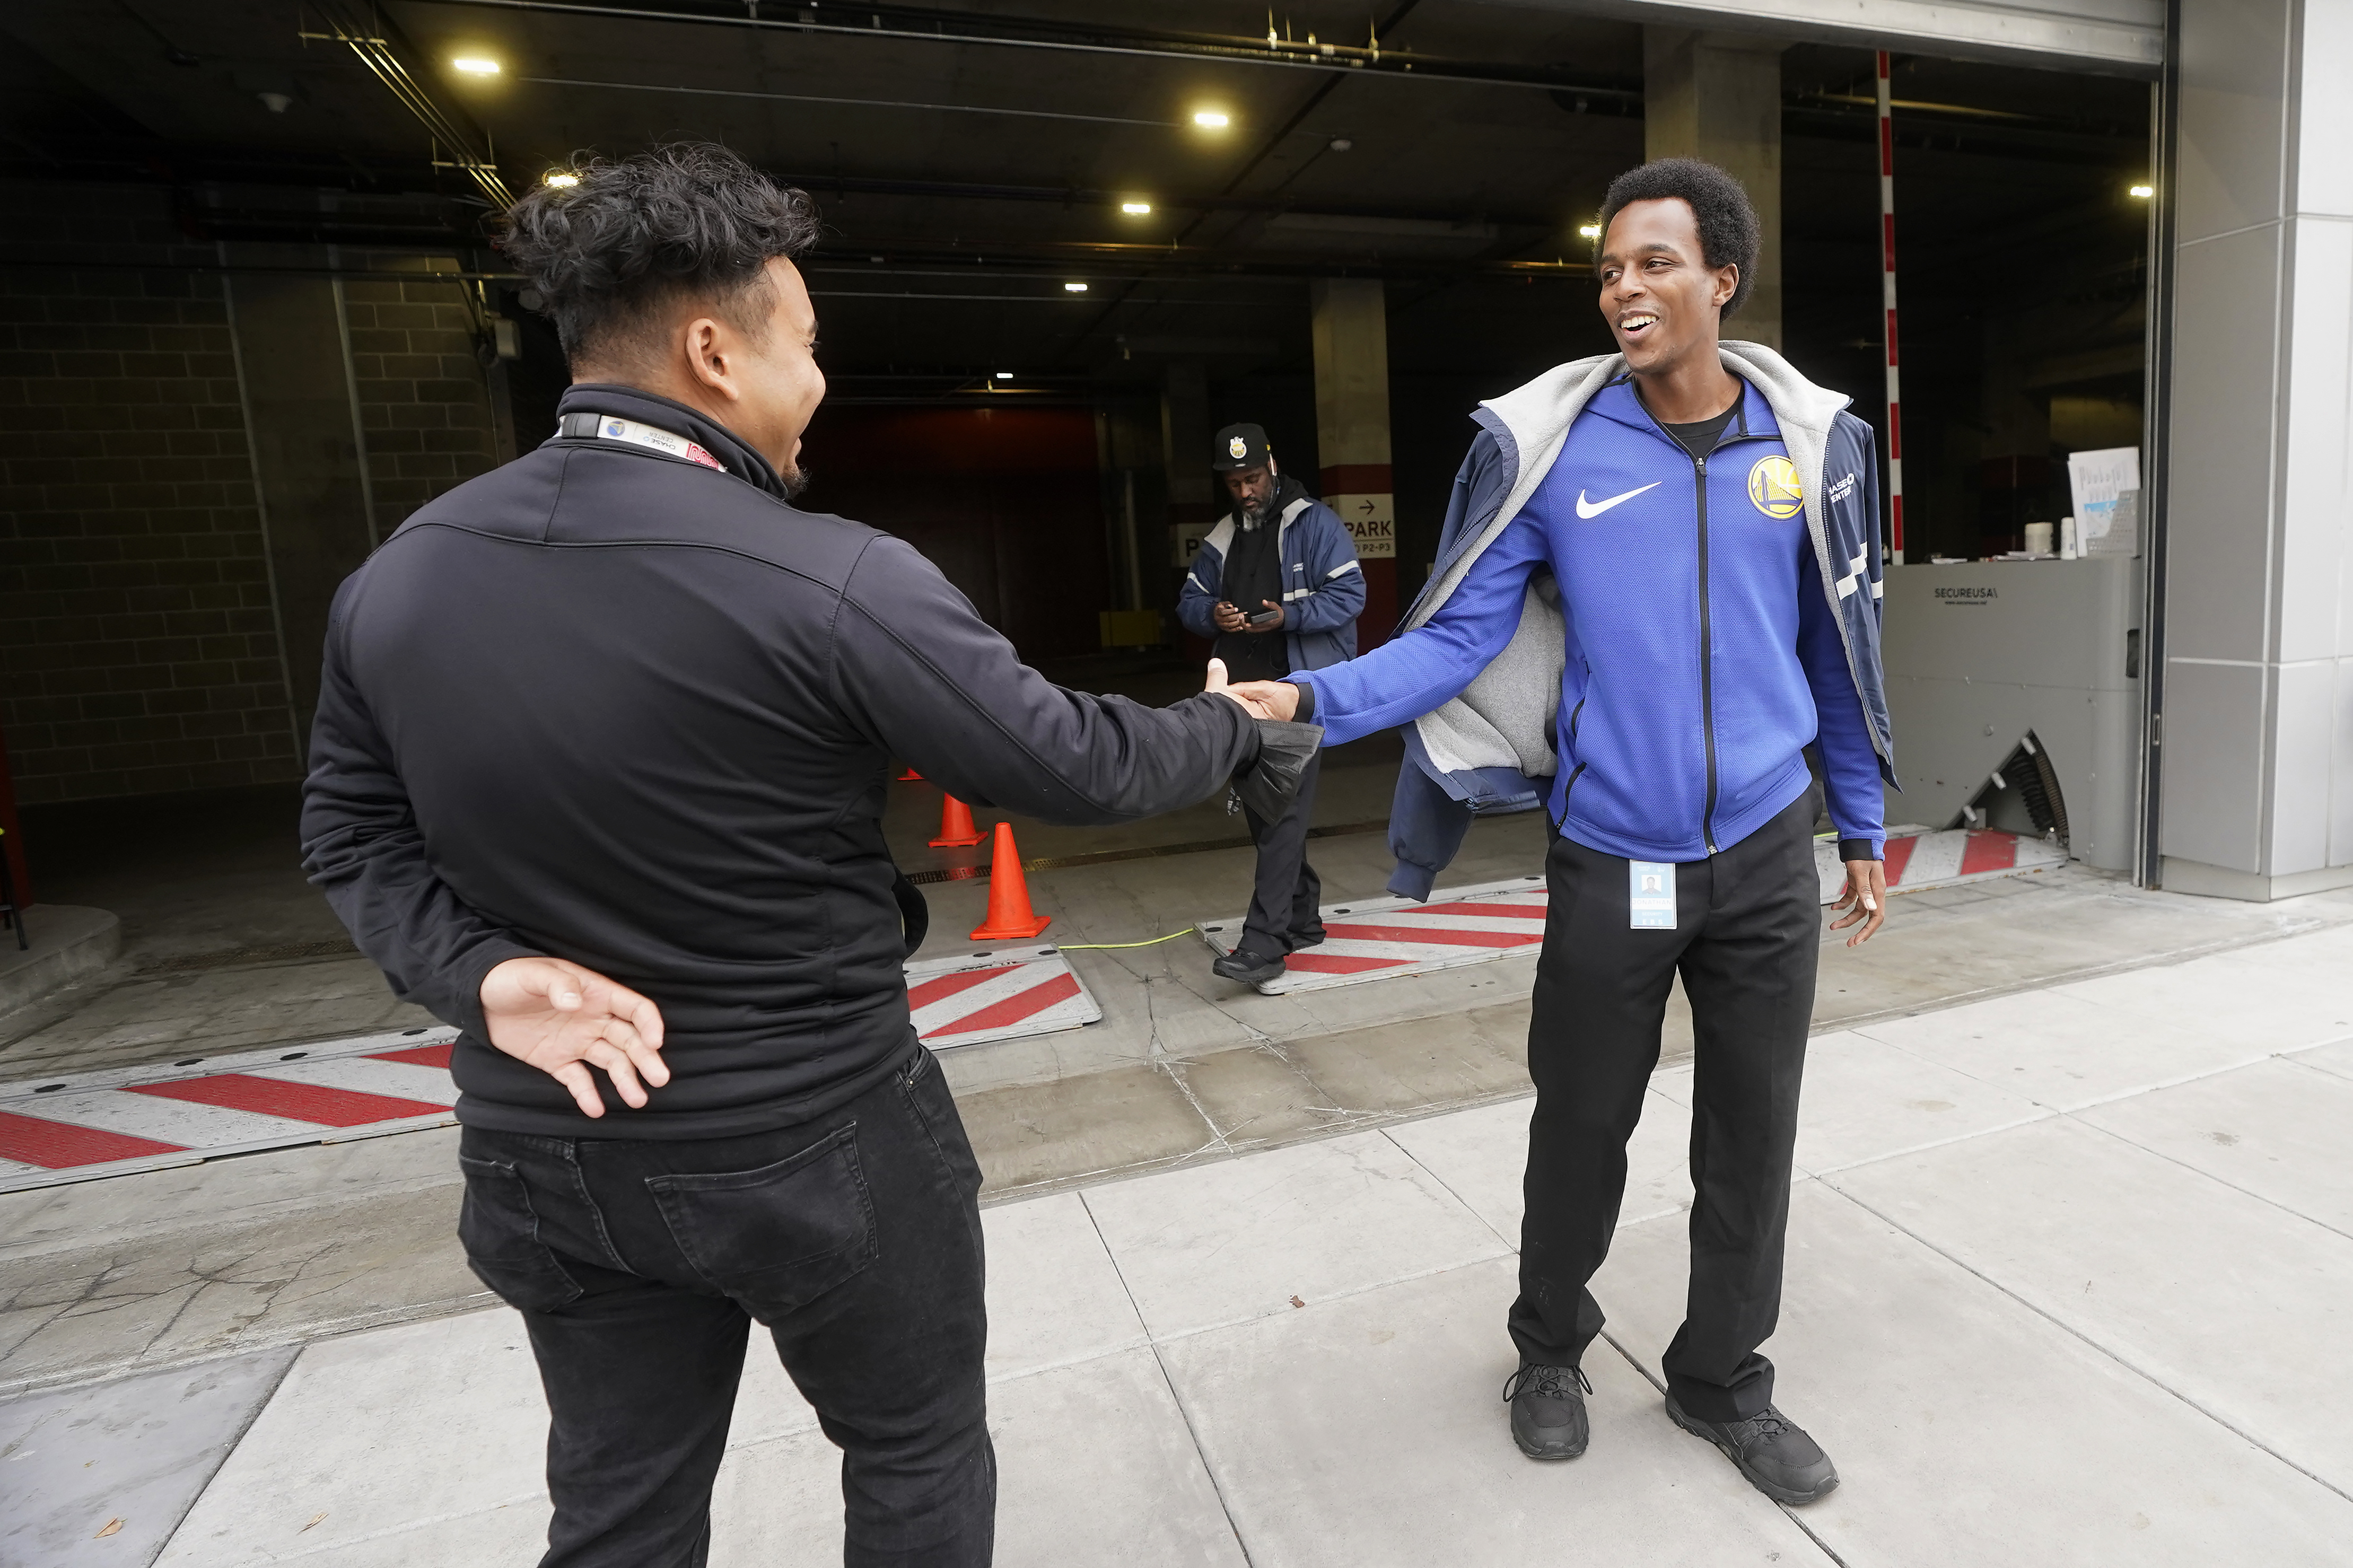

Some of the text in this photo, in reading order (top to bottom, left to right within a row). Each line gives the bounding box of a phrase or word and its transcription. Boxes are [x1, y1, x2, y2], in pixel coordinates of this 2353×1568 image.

[649, 432, 673, 443] CENTER
[651, 439, 676, 450] CHASE
[1829, 478, 1848, 495] HASE
[1830, 486, 1851, 503] ENTER
[1344, 520, 1391, 537] PARK
